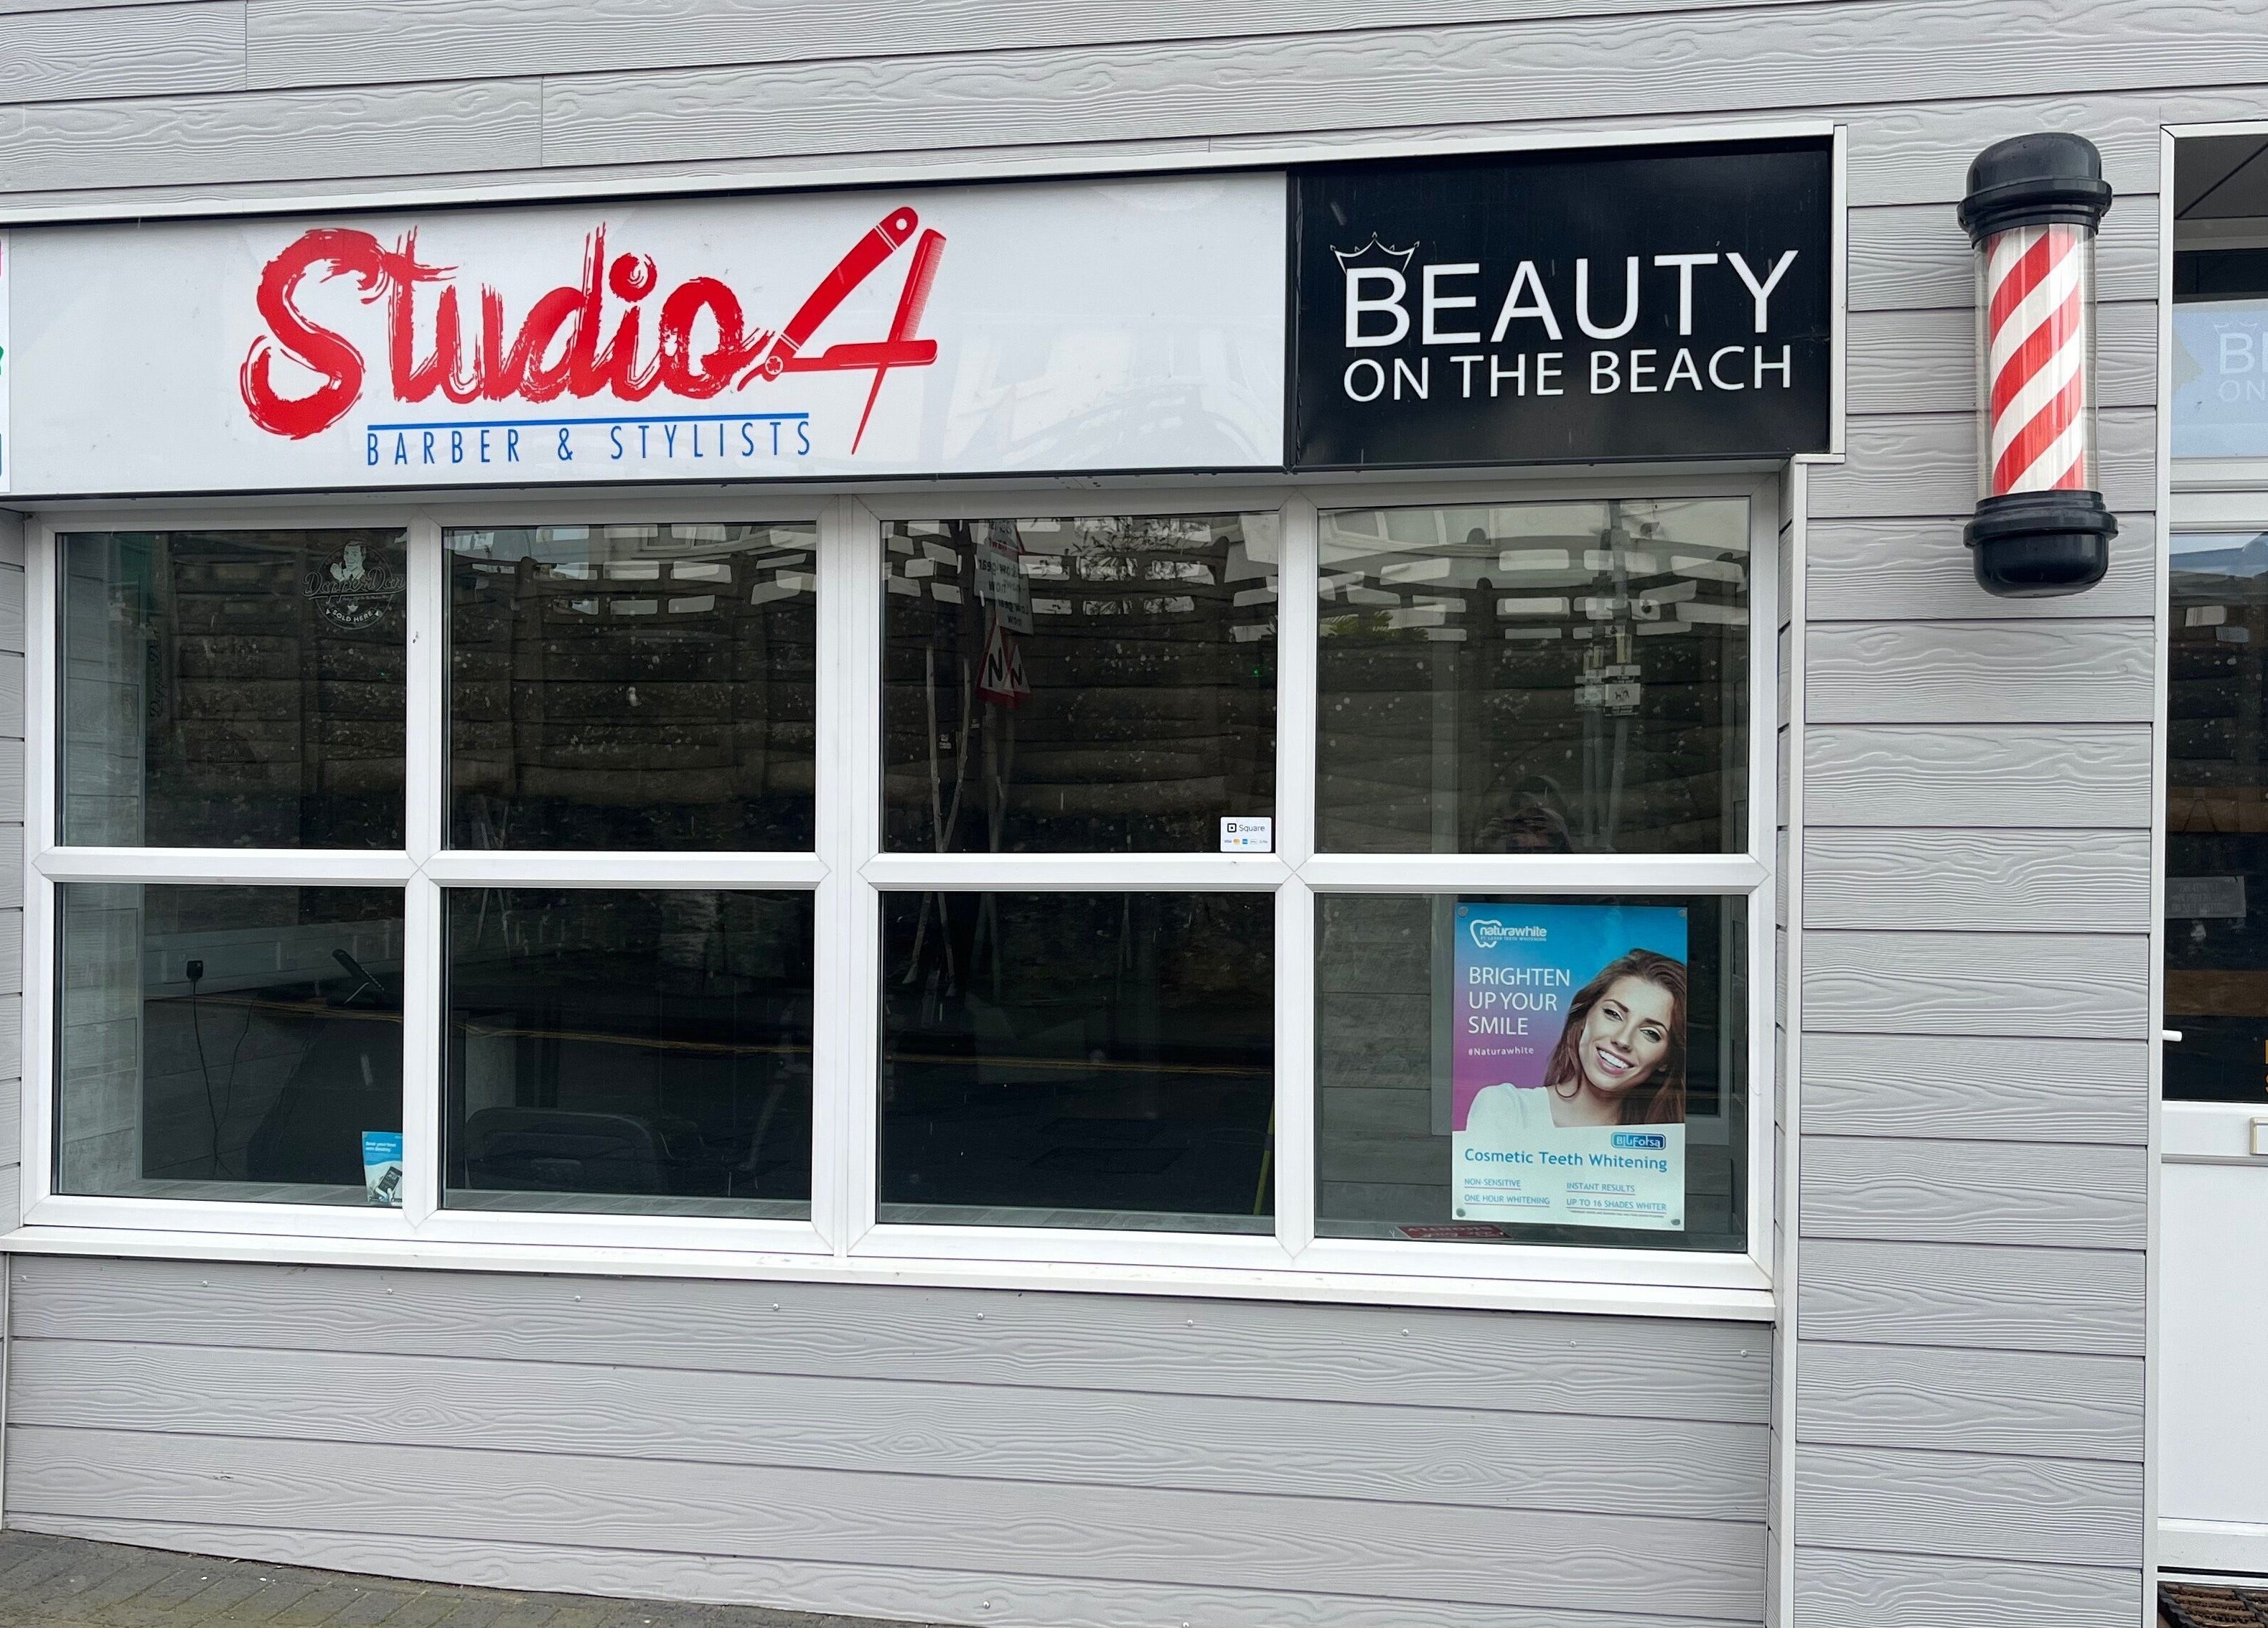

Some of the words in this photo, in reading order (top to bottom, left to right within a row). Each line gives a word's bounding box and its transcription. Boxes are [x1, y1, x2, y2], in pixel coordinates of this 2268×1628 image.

[1345, 249, 1799, 348] BEAUTY
[240, 222, 774, 440] Studio
[2219, 332, 2268, 375] B
[1343, 357, 1429, 402] ON
[1449, 352, 1564, 398] THE
[1590, 344, 1791, 395] BEACH
[367, 429, 521, 467] BARBER
[558, 427, 574, 462] &
[610, 421, 810, 460] STYLISTS
[301, 571, 371, 604] Dapper
[367, 566, 405, 591] Dan
[332, 609, 352, 622] SOLD
[353, 610, 373, 622] HERE
[1239, 824, 1265, 833] Square
[1479, 925, 1547, 937] naturawhite
[1469, 966, 1570, 987] BRIGHTEN
[1468, 991, 1496, 1009] UP
[1499, 992, 1557, 1011] YOUR
[1468, 1016, 1529, 1036] SMILE
[1468, 1046, 1534, 1057] #Naturawhite
[1465, 1148, 1534, 1164] Cosmetic
[1538, 1151, 1583, 1166] Teeth
[1588, 1154, 1667, 1173] Whitening
[1566, 1182, 1599, 1191] INSTANT
[1601, 1184, 1636, 1192] RESULTS
[1482, 1194, 1504, 1203] HOUR
[1506, 1196, 1550, 1204] WHITENING
[1604, 1200, 1634, 1209] SHADES
[1635, 1202, 1667, 1211] WHITER
